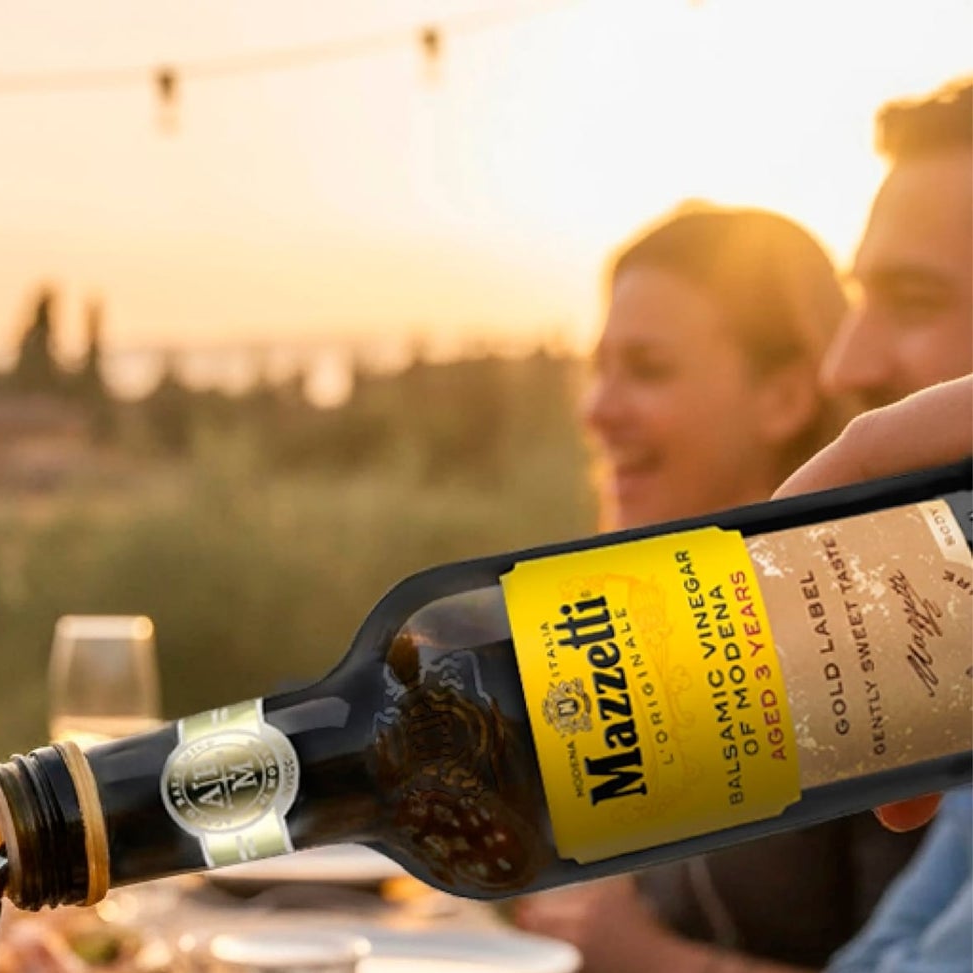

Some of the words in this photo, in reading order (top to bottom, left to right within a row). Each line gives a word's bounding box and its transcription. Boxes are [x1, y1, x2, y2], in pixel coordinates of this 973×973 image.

[822, 536, 853, 595] TASTE
[674, 549, 717, 661] VINEGAR
[729, 570, 765, 658] YEARS
[799, 569, 835, 654] LABEL
[845, 600, 876, 673] SWEET
[540, 621, 561, 678] ITALIA
[709, 584, 751, 710] MODENA
[754, 664, 772, 681] 3
[553, 594, 649, 807] Mazzetti
[613, 607, 675, 765] L'ORIGINALE
[823, 662, 850, 736] GOLD
[863, 679, 887, 756] GENTLY
[707, 668, 744, 806] BALSAMIC
[739, 721, 760, 756] OF
[760, 689, 787, 761] AGED
[566, 741, 585, 798] MODENA
